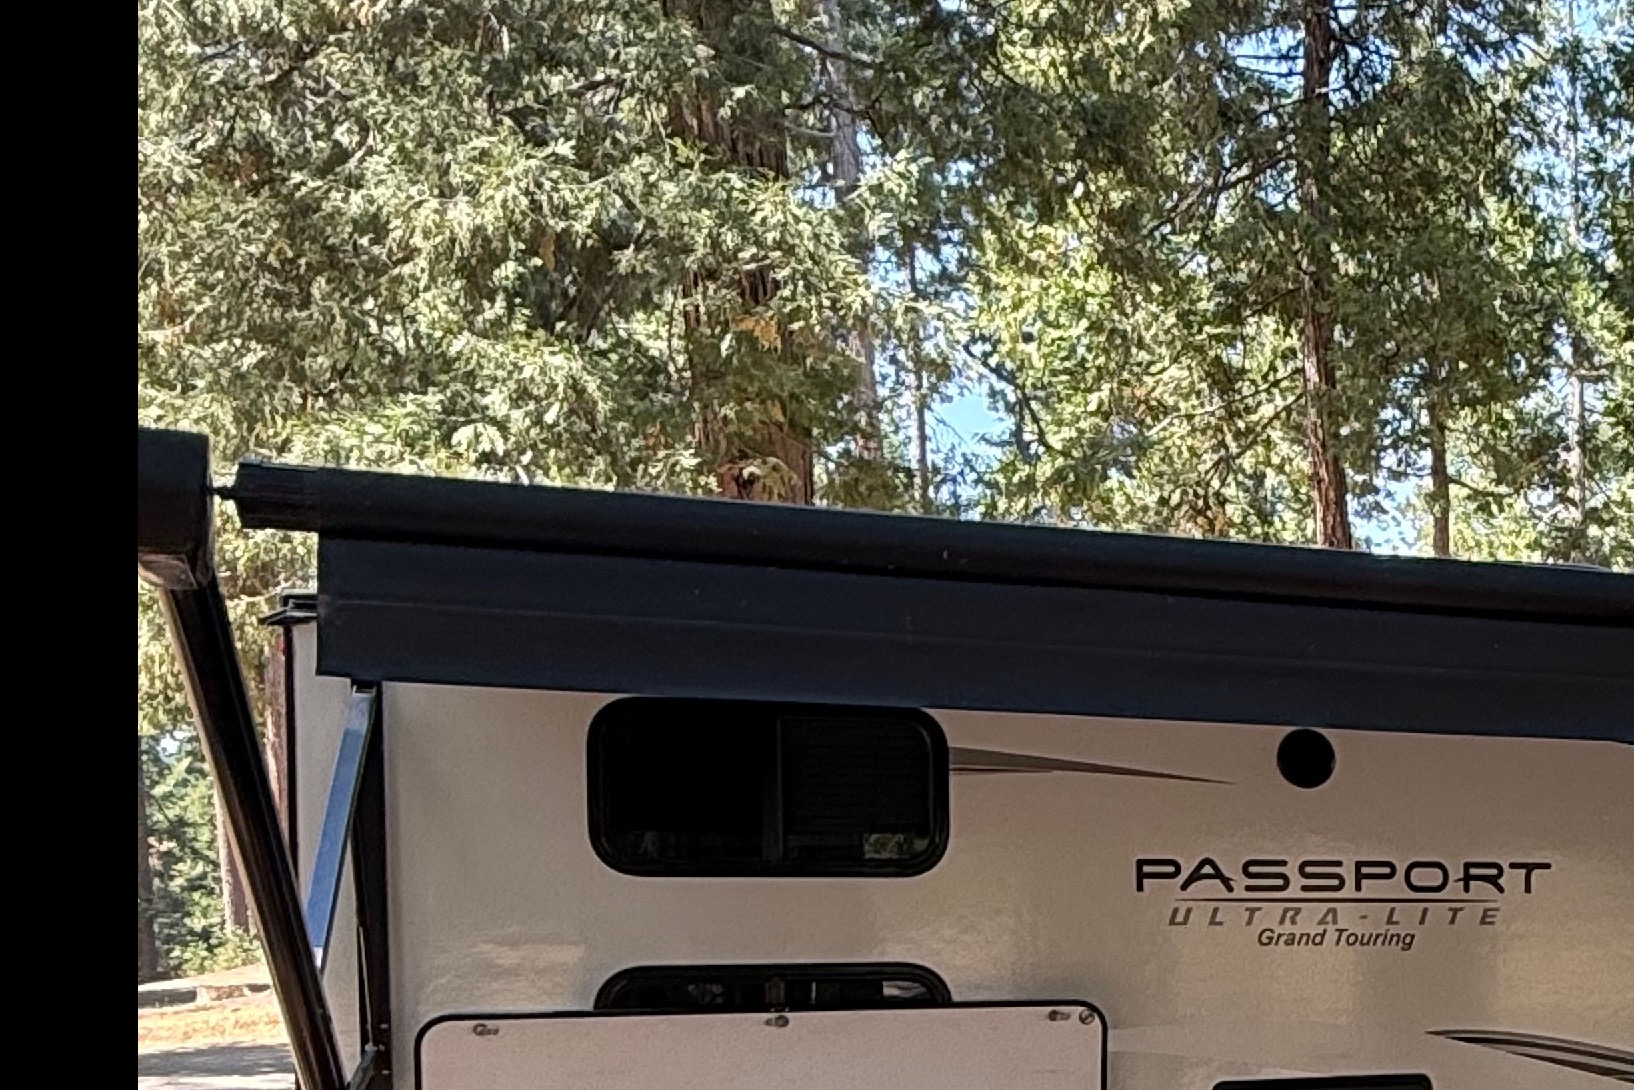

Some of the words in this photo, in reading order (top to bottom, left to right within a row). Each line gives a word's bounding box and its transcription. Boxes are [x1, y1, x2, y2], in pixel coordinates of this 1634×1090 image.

[1135, 857, 1552, 894] PASSPORT
[1168, 906, 1500, 926] ULTRA-LITE
[1257, 928, 1327, 947] Grand
[1333, 928, 1415, 951] Touring
